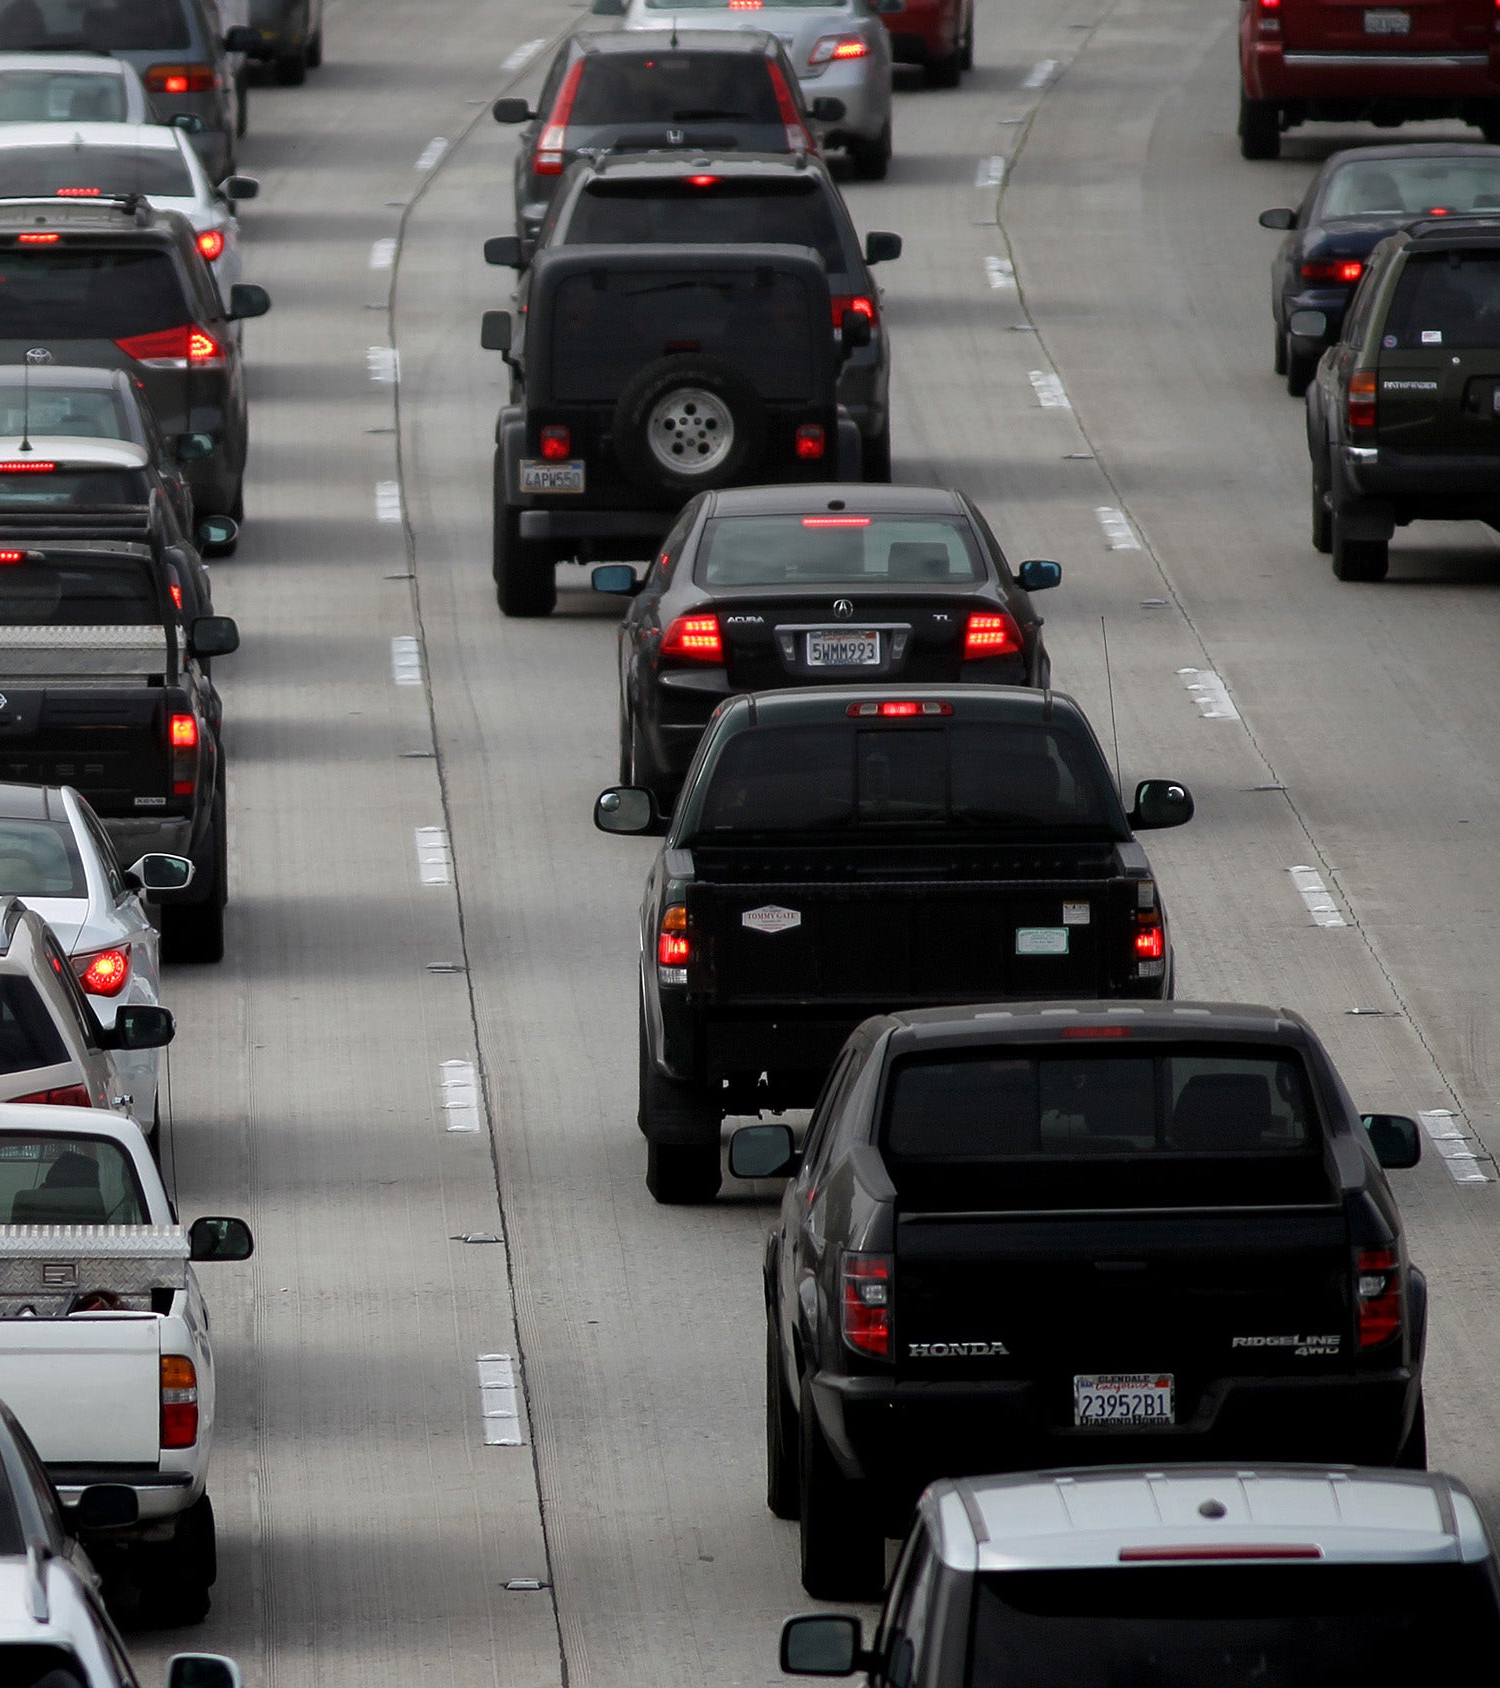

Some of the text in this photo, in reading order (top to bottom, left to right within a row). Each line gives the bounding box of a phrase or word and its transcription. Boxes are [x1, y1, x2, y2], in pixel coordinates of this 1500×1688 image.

[1383, 381, 1437, 389] PATHFINDER
[812, 642, 875, 660] 5WMM993
[1231, 1334, 1341, 1348] RIDGELINE
[908, 1341, 1010, 1357] HONDA
[1294, 1346, 1340, 1356] 4WD
[1097, 1375, 1151, 1383] GLENDALE
[1081, 1394, 1168, 1417] 23952B1
